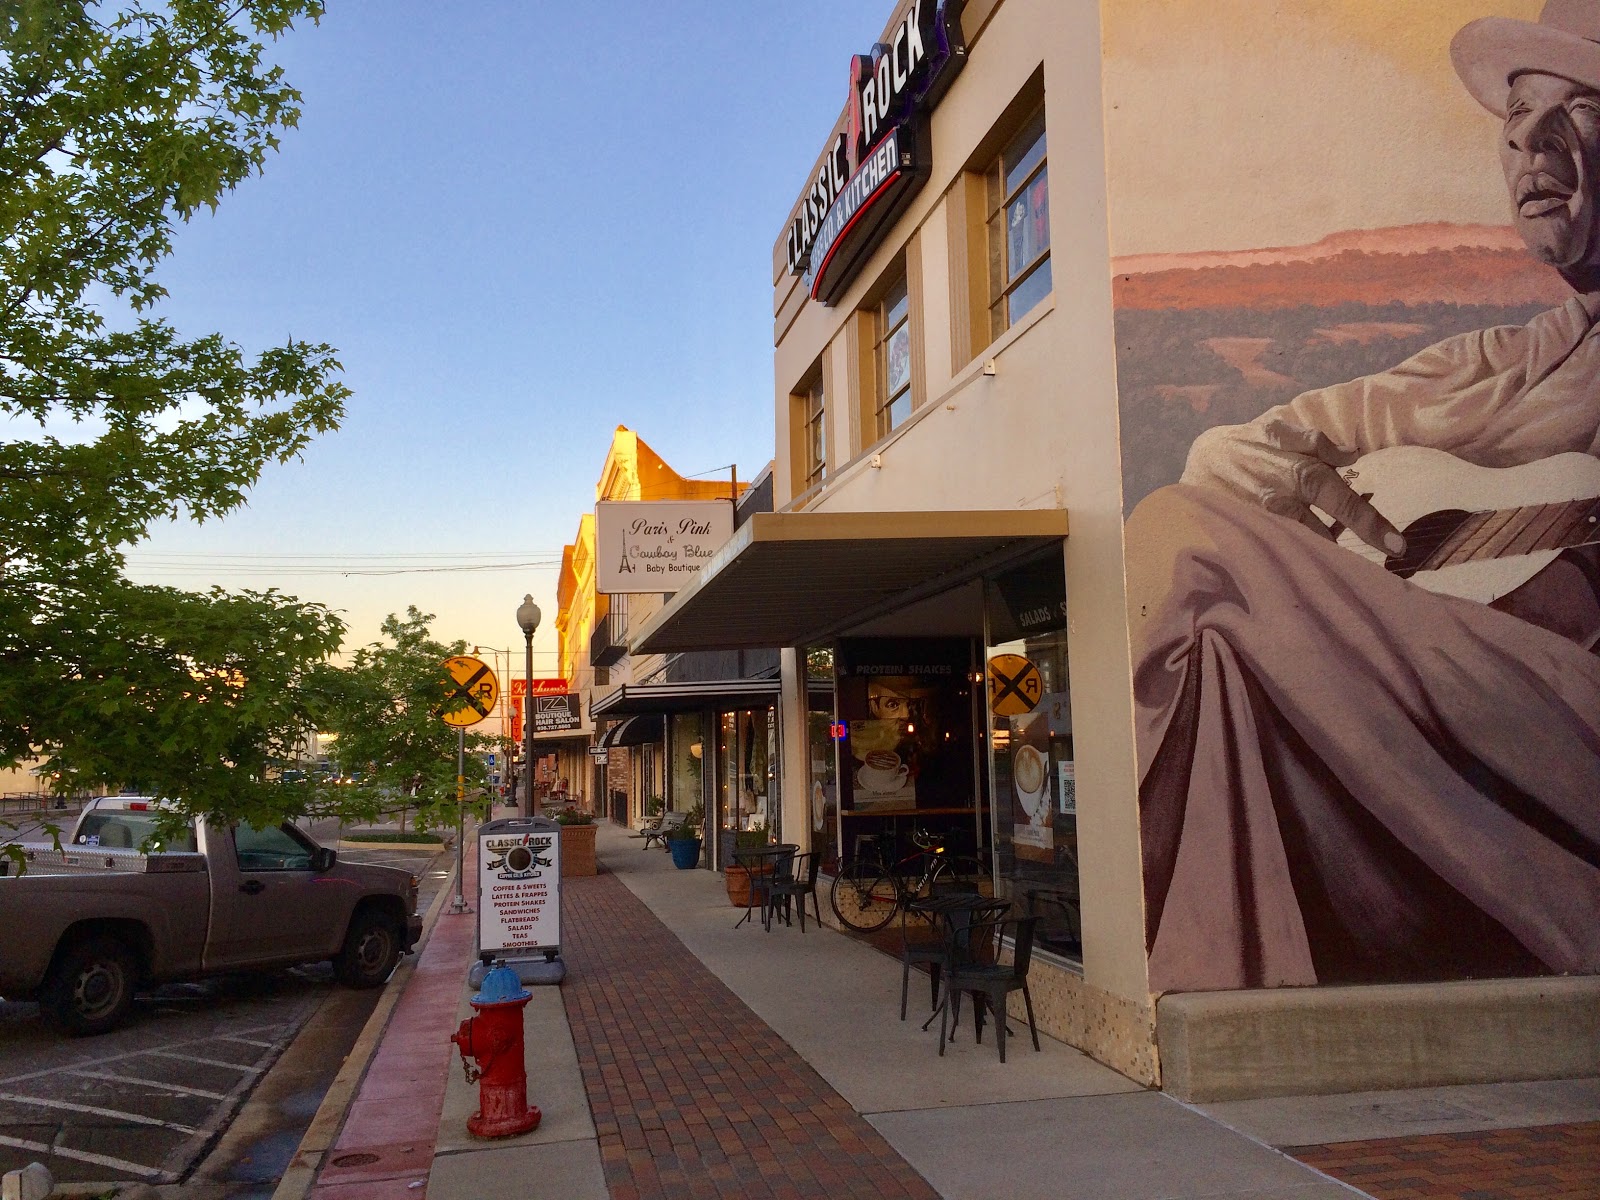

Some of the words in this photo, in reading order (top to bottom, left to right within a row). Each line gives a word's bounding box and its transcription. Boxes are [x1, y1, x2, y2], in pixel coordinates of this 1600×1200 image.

[786, 136, 844, 276] CLASSIC
[863, 0, 924, 146] ROCK
[836, 202, 844, 230] &
[845, 137, 897, 219] KITCHEN
[629, 518, 667, 535] Paris
[676, 518, 711, 535] Pink
[630, 545, 677, 560] Cowboy
[683, 544, 713, 558] Blue
[646, 564, 665, 574] Baby
[668, 563, 701, 573] Boutique
[1019, 606, 1050, 627] SALADS
[856, 665, 903, 675] PROTEIN
[908, 665, 951, 674] SHAKES
[480, 683, 493, 699] R
[514, 681, 566, 694] Kechum's
[535, 711, 572, 720] BOUTIQUE
[536, 718, 554, 726] HAIR
[556, 716, 580, 724] SALON
[486, 838, 522, 848] CLASSIC
[528, 836, 552, 846] ROCK
[499, 908, 541, 916] SANDWICHES
[501, 916, 540, 924] FLATBREADS
[508, 924, 533, 932] SALADS
[502, 940, 538, 948] SMOOTHIES
